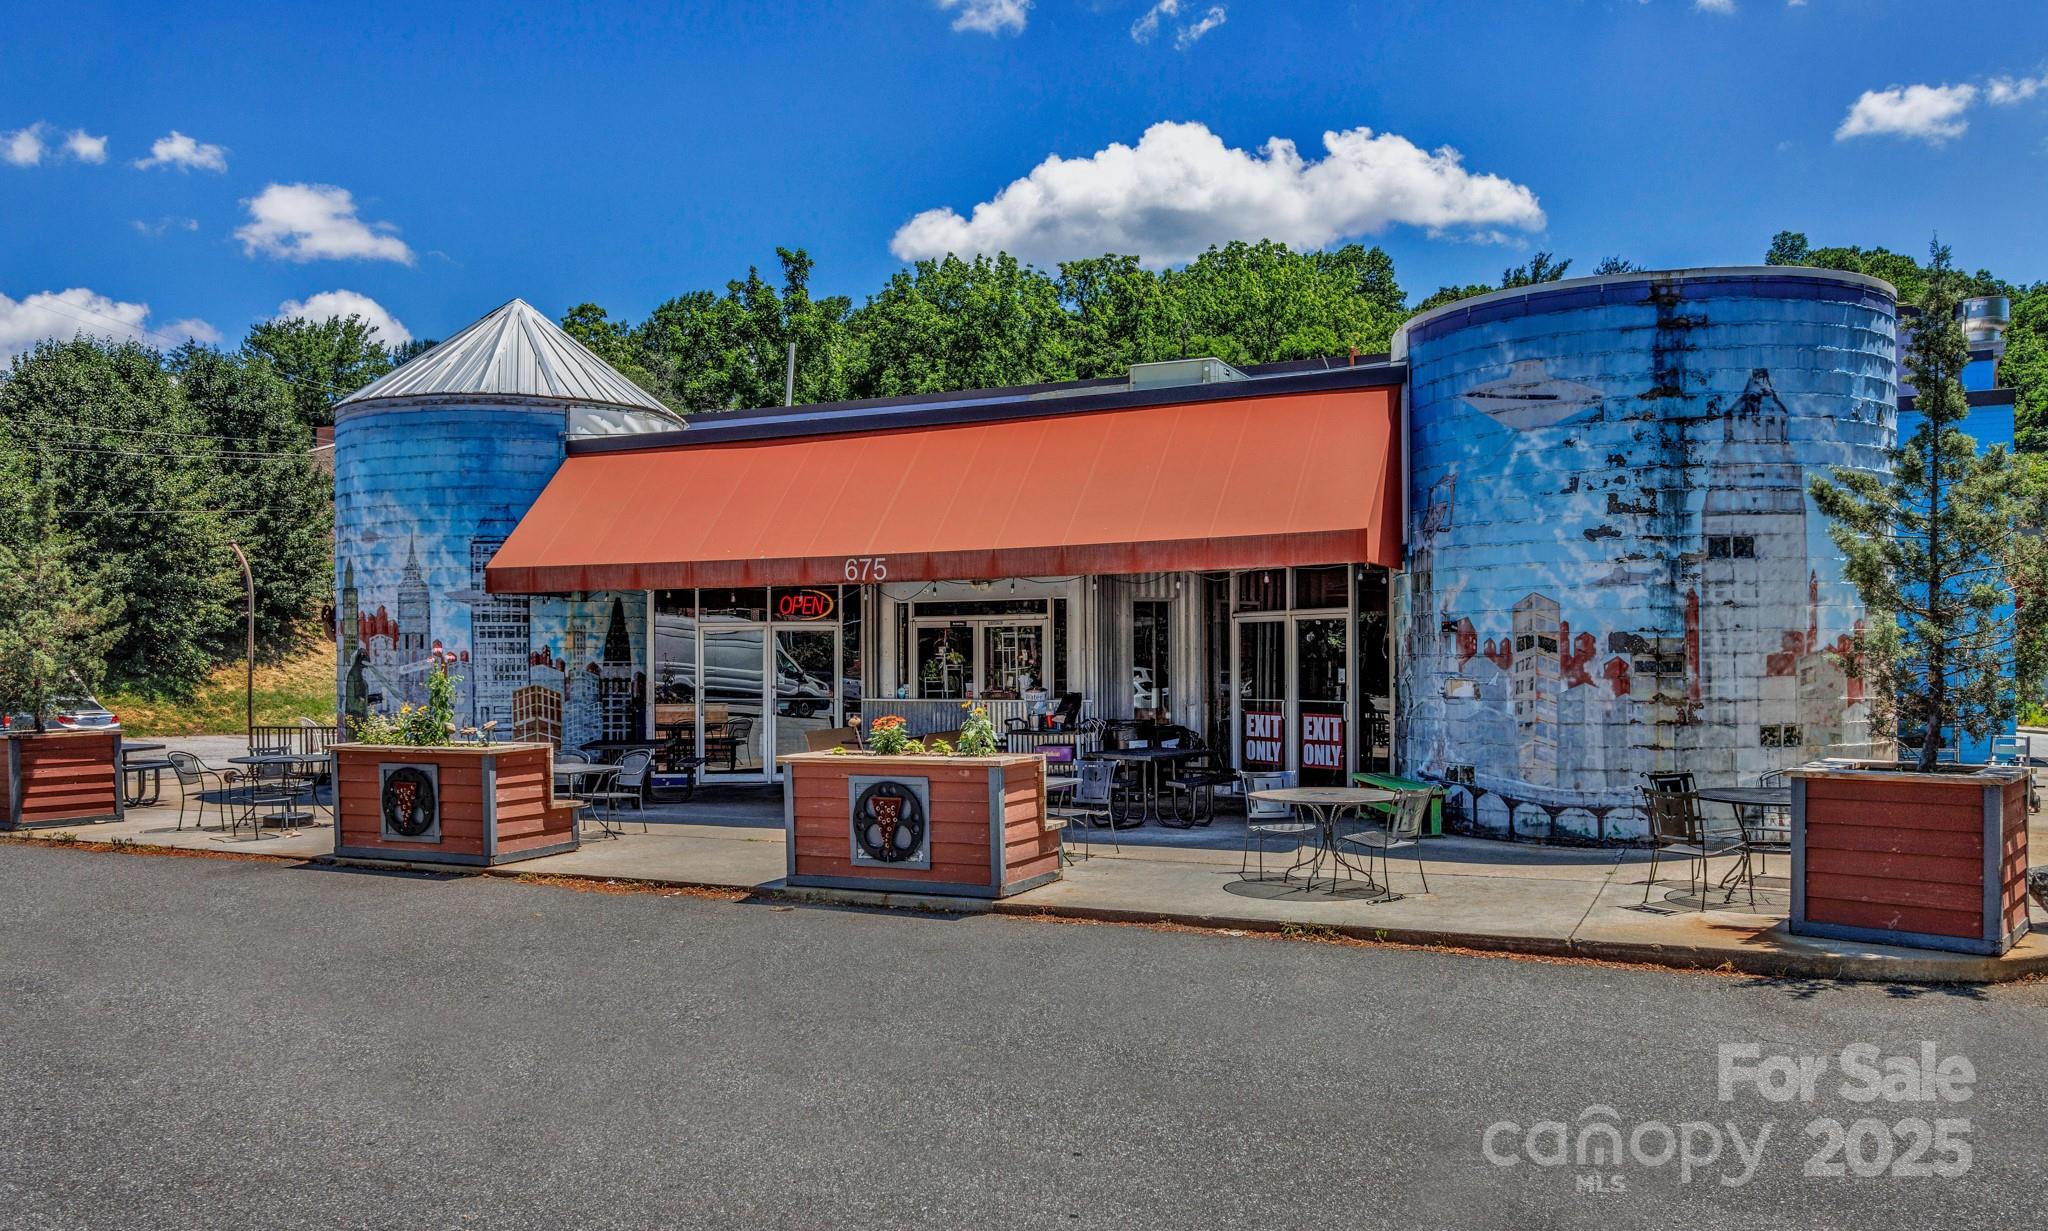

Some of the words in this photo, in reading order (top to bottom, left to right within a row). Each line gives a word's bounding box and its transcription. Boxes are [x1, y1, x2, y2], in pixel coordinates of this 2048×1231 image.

[844, 558, 887, 580] 675
[780, 595, 825, 615] OPEN
[1246, 714, 1281, 738] EXIT
[1303, 716, 1342, 741] EXIT
[1246, 740, 1281, 762] ONLY
[1303, 743, 1342, 767] ONLY
